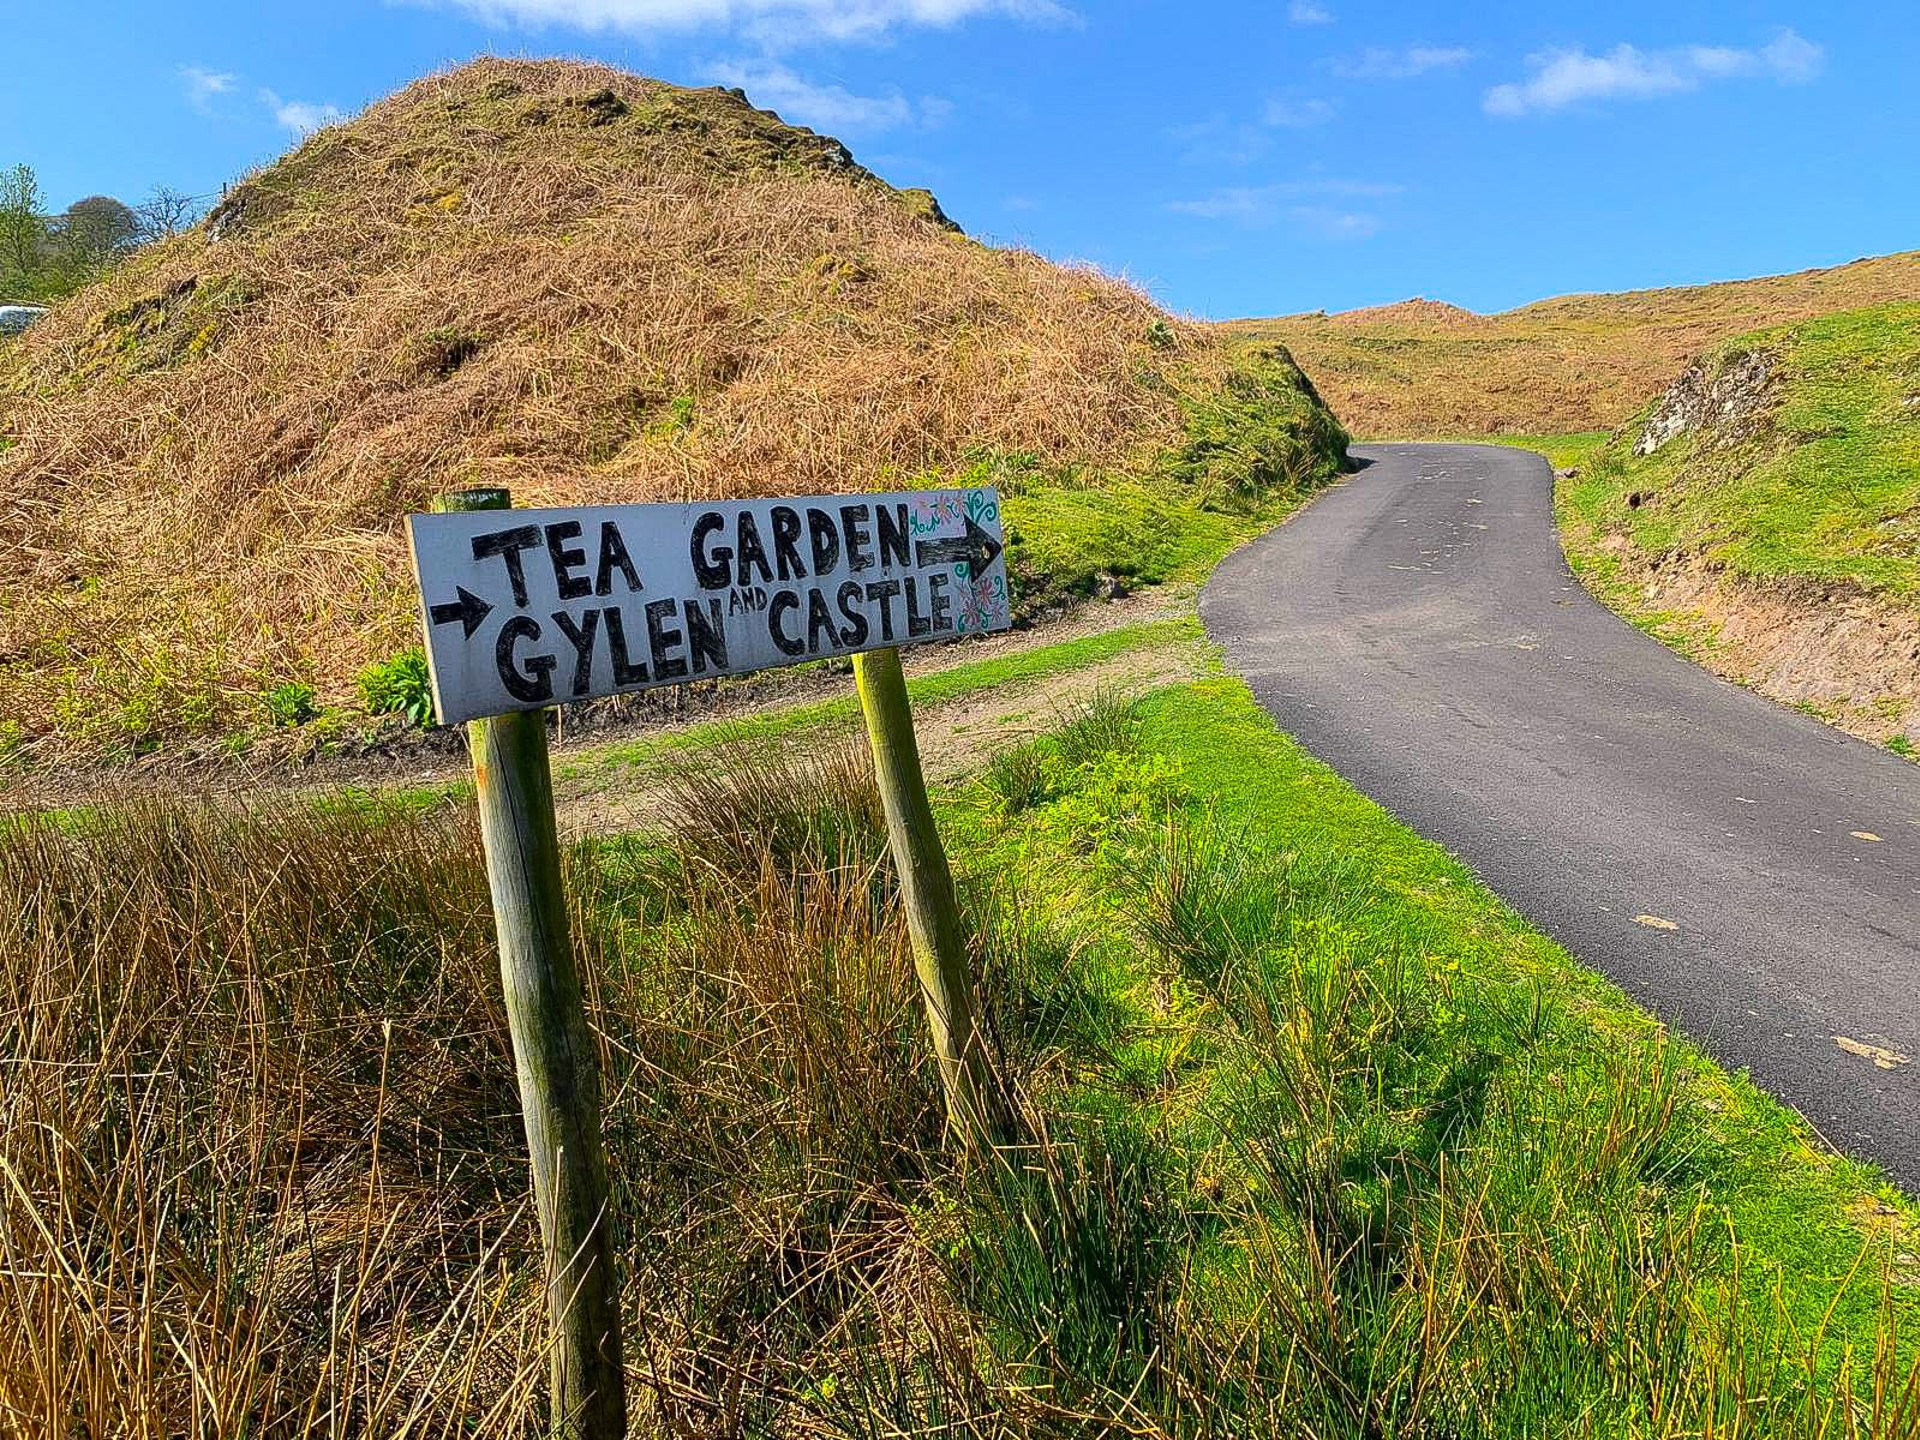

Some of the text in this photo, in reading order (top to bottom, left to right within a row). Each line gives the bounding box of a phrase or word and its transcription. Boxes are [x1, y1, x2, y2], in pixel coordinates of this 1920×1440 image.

[471, 503, 912, 607] TEA GARDEN
[496, 573, 953, 702] GYLEN AND CASTLE
